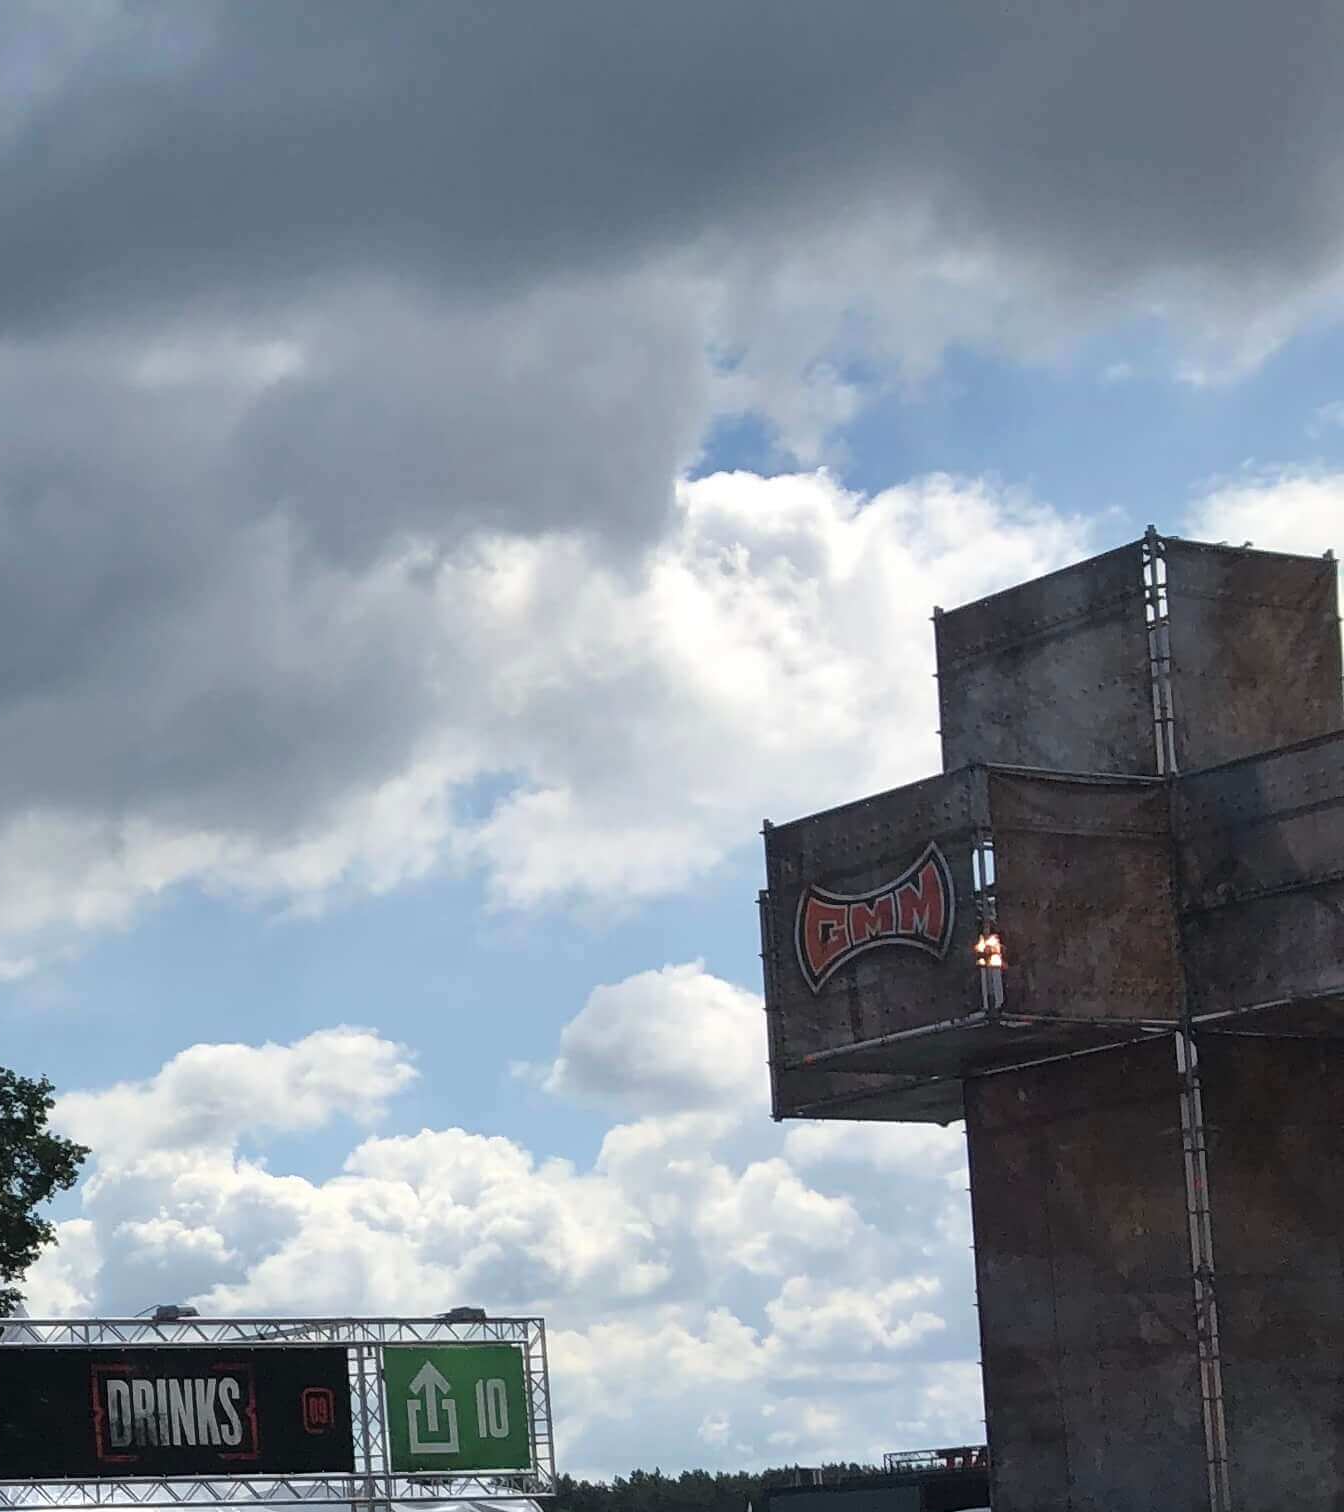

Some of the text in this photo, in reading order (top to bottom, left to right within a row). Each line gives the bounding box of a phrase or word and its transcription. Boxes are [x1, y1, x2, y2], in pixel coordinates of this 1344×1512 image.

[805, 861, 945, 976] GMM
[106, 1377, 243, 1447] DRINKS
[475, 1378, 510, 1438] 10
